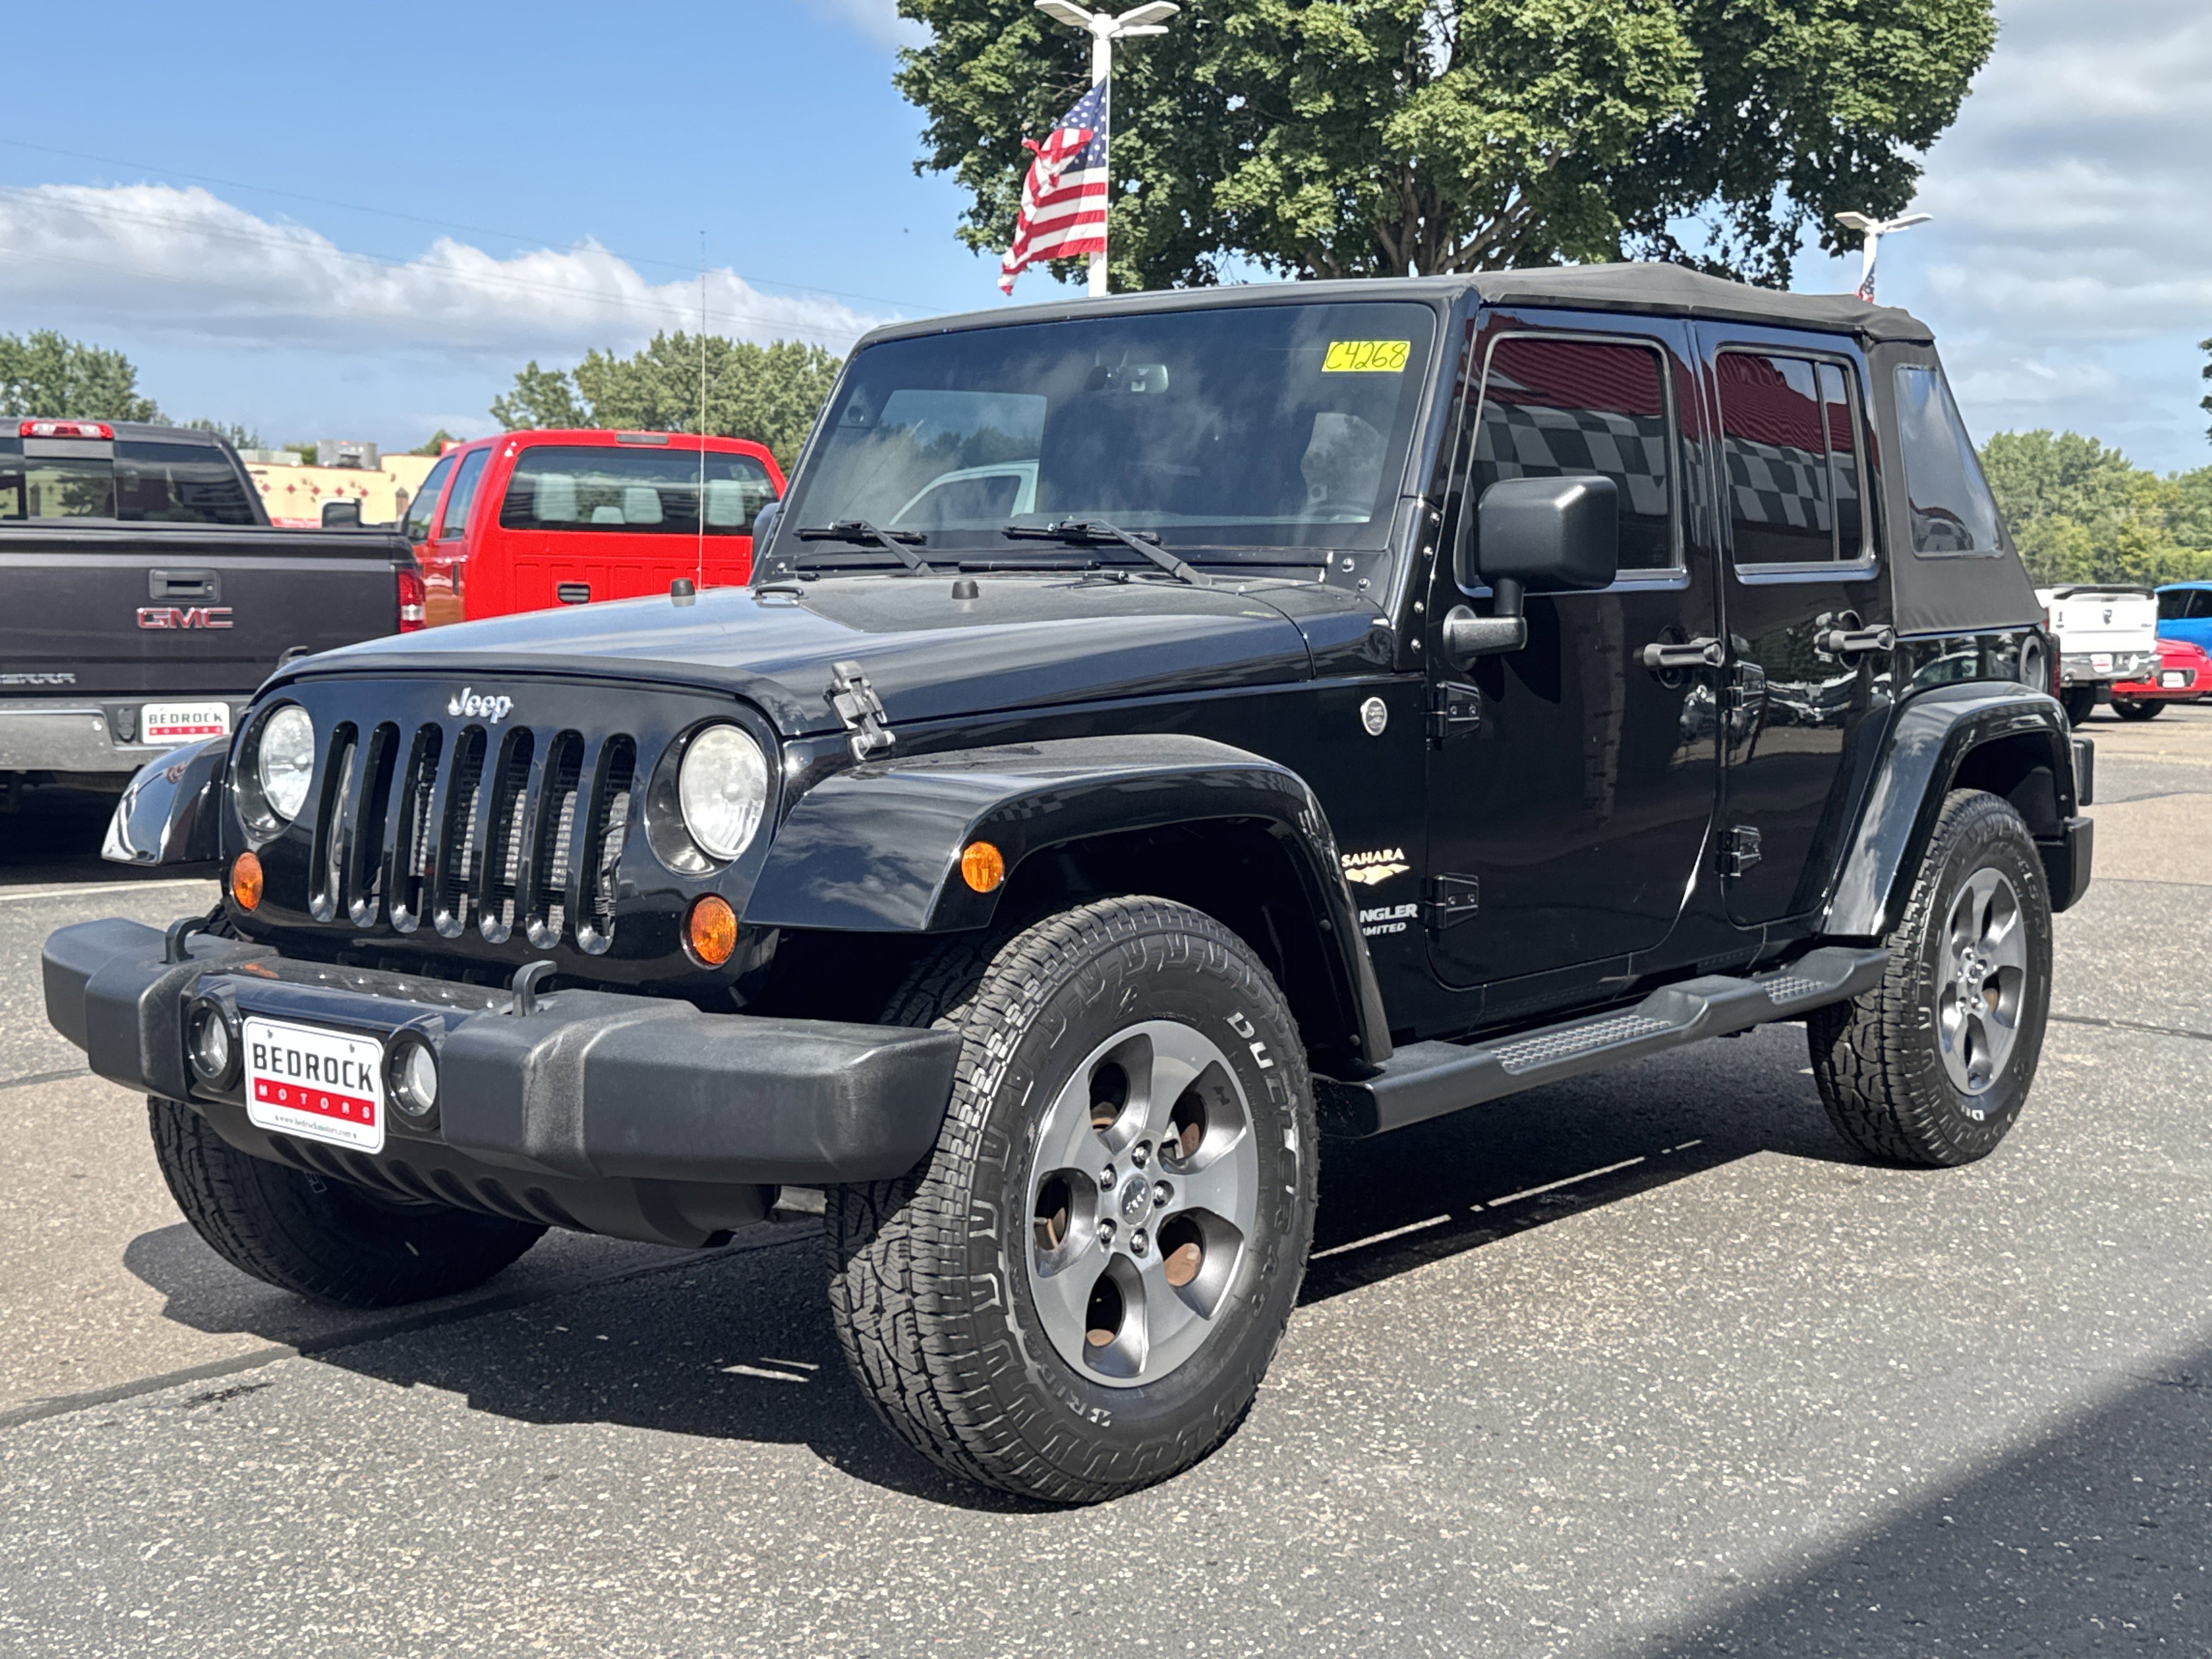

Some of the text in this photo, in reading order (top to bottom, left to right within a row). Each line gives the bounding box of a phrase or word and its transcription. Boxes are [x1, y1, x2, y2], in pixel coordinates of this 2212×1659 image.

[1326, 342, 1408, 370] C4268
[137, 607, 234, 629] GMC
[0, 673, 76, 684] ERRA
[448, 686, 514, 724] Jeep
[149, 713, 223, 725] BEDROCK
[1341, 848, 1405, 867] SAHARA
[1359, 903, 1418, 923] NGLER
[252, 1042, 374, 1093] BEDROCK
[258, 1084, 370, 1119] MOTORS
